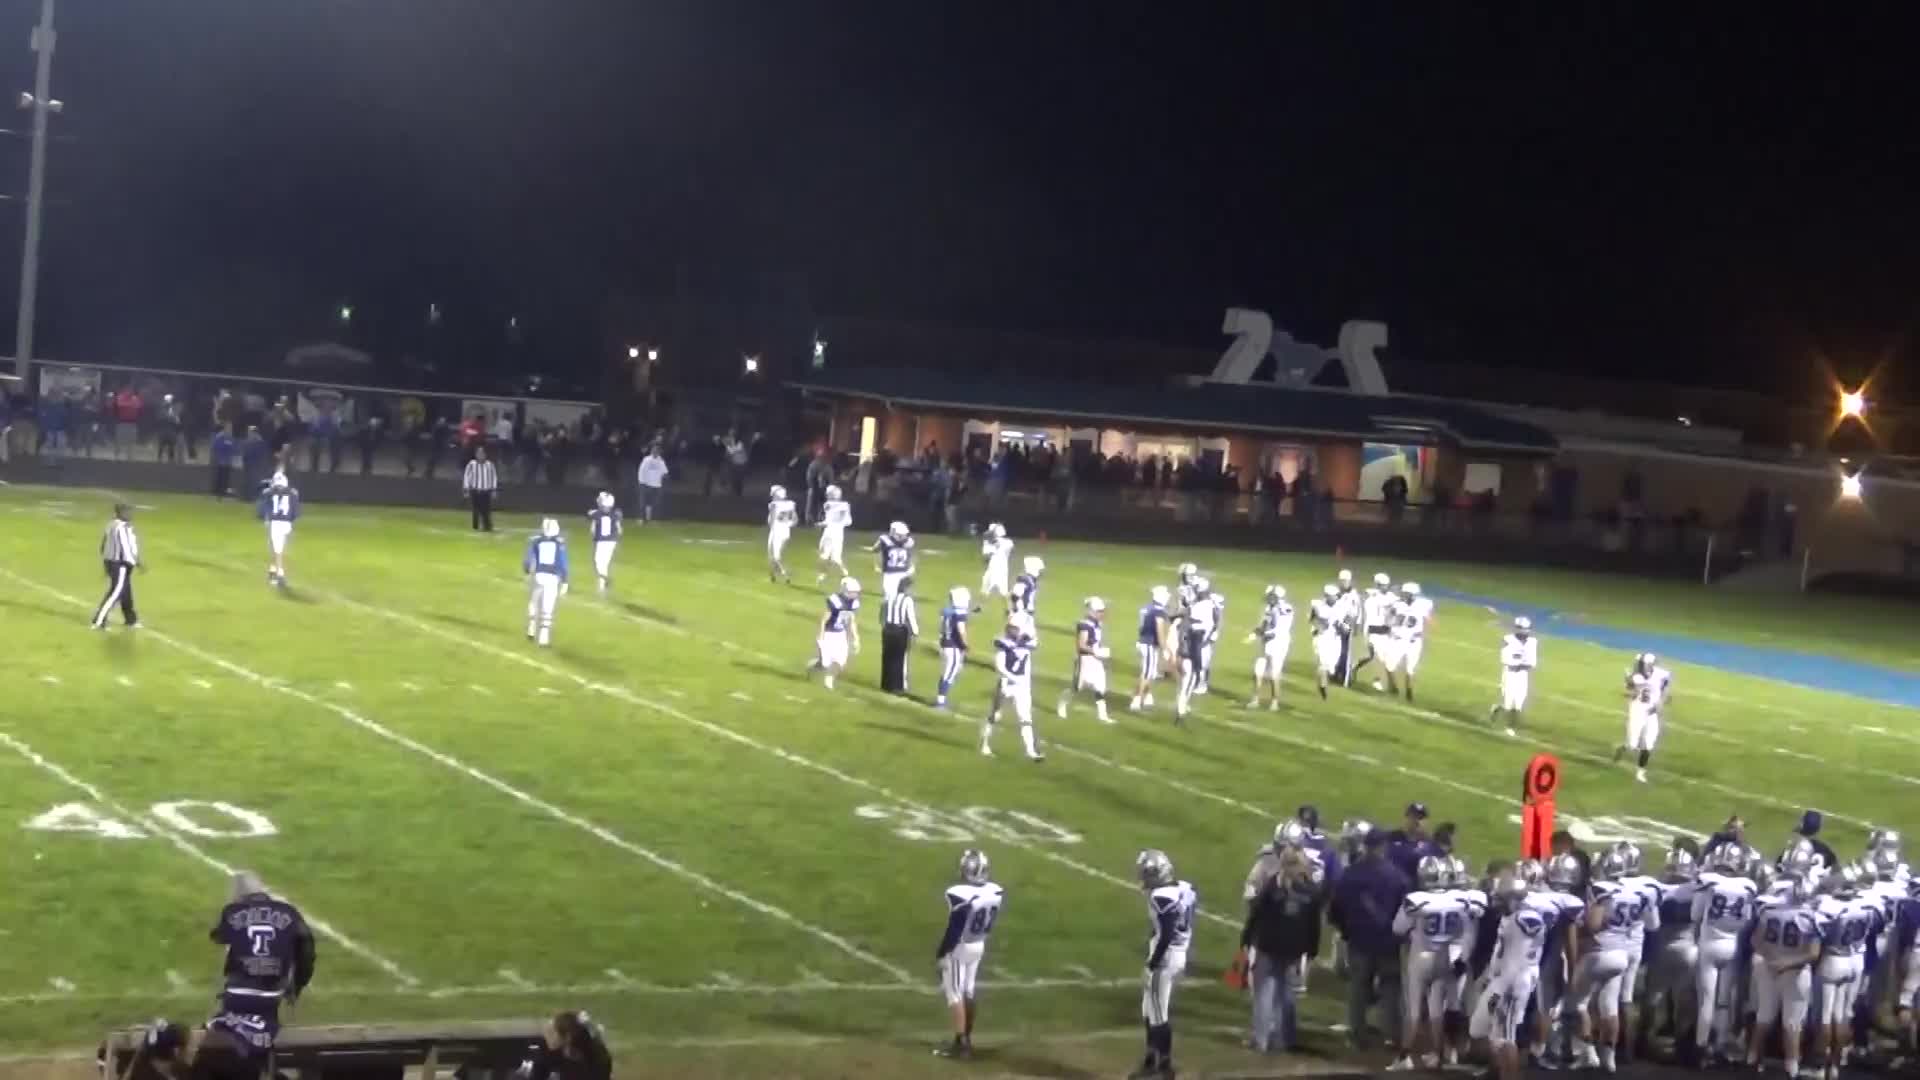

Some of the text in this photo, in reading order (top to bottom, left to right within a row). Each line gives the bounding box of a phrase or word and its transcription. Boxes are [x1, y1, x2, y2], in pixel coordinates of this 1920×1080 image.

[272, 494, 292, 515] 14
[888, 547, 908, 568] 32
[25, 800, 279, 839] 40
[854, 805, 1083, 842] 30
[247, 924, 276, 957] T
